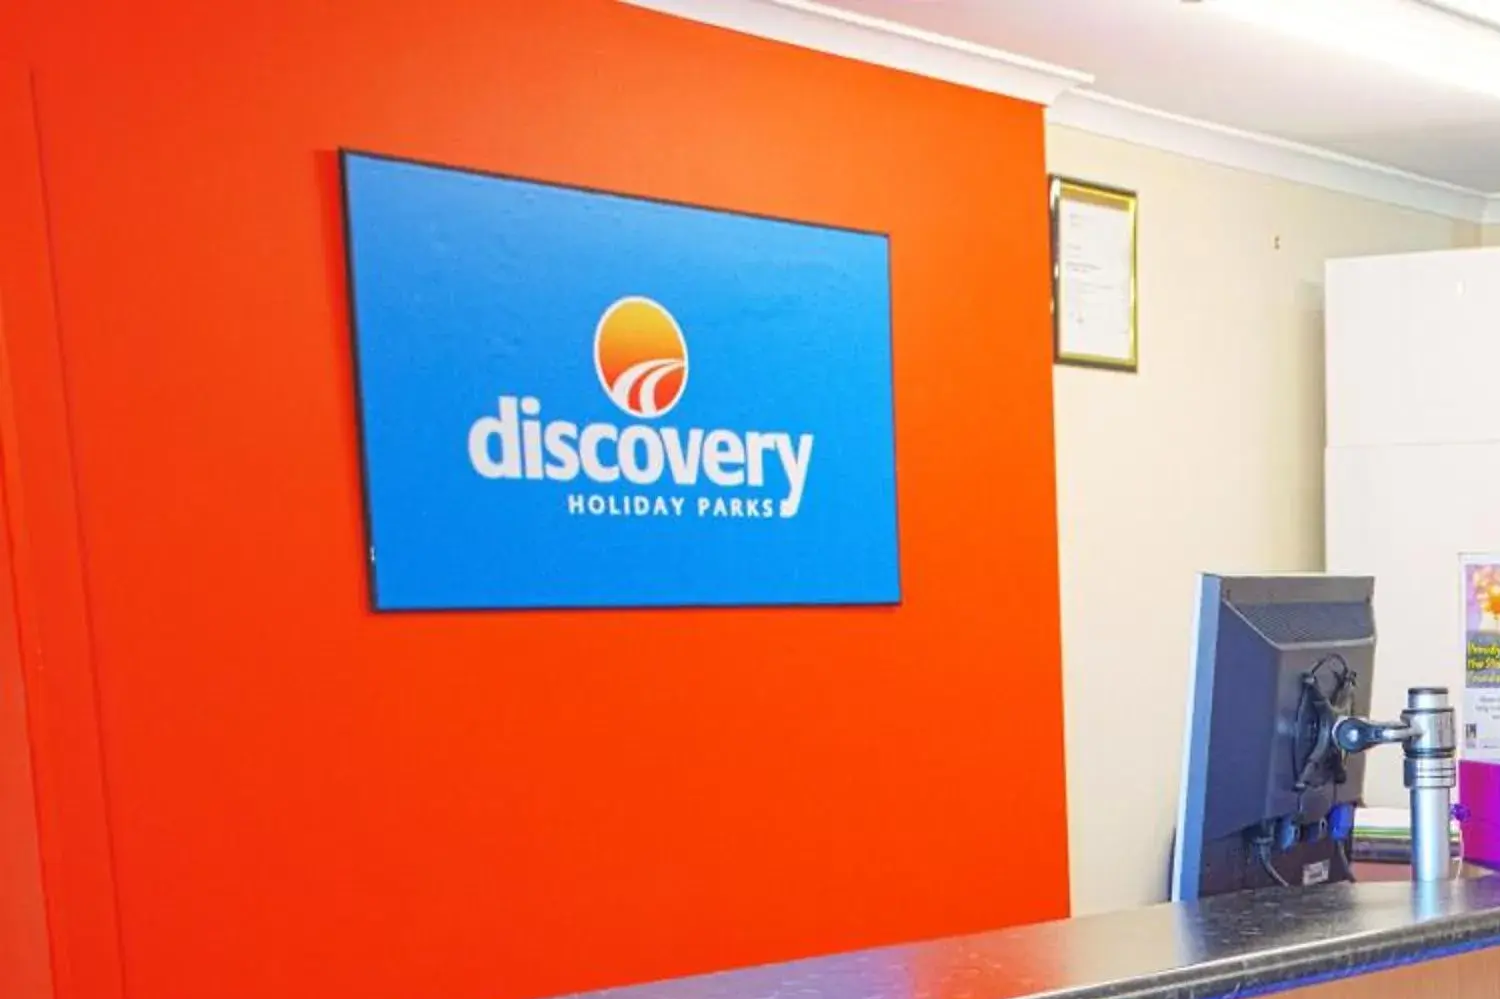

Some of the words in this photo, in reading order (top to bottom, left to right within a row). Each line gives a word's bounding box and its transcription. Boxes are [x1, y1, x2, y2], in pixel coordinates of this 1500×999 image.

[468, 396, 814, 519] discovery
[568, 494, 685, 517] HOLIDAY
[698, 498, 774, 518] PARKS
